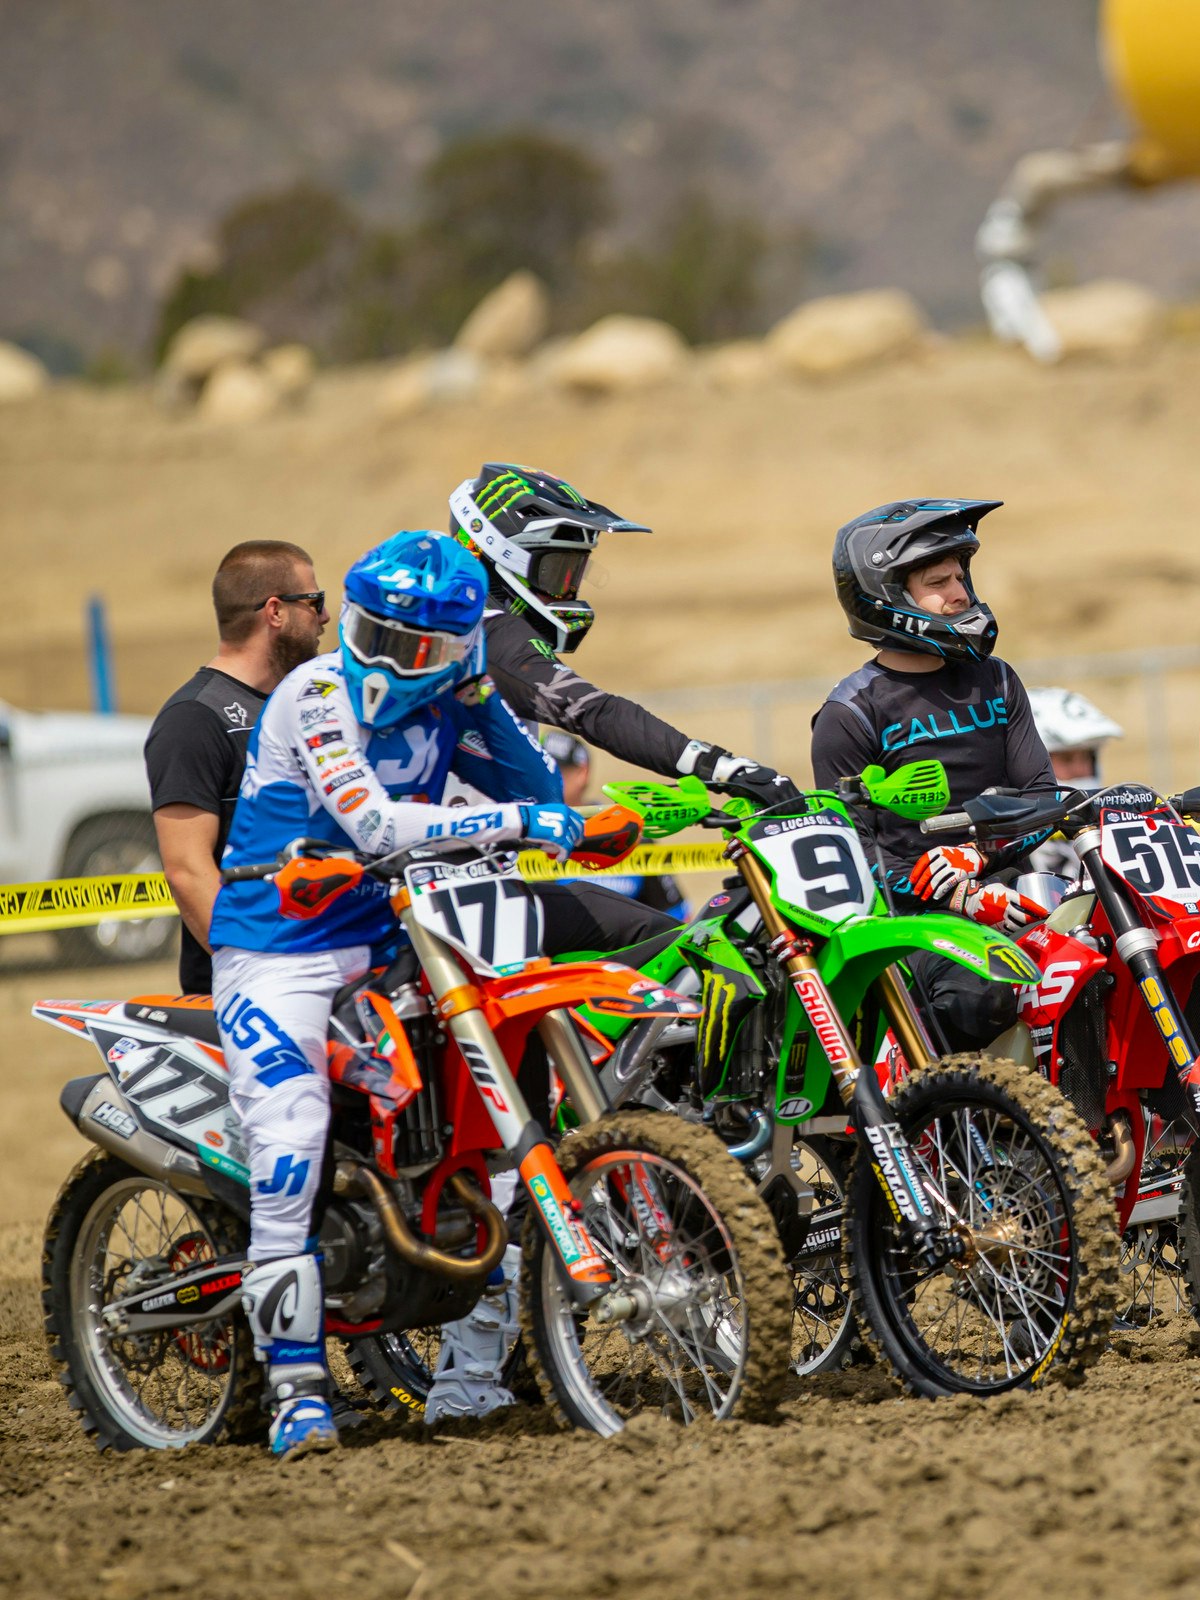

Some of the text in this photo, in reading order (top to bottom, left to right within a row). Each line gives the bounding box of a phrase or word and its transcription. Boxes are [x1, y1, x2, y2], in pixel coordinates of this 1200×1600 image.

[892, 612, 930, 637] FLY
[880, 697, 1008, 750] CALLUS
[643, 807, 700, 821] ACERBIS
[781, 815, 832, 832] LUCAS OIL
[889, 791, 947, 804] ACERBIS
[468, 863, 492, 877] OIL
[791, 833, 864, 911] 9
[428, 878, 540, 966] 177
[788, 904, 827, 926] Kawasaki
[216, 991, 314, 1089] UST1
[793, 979, 851, 1064] SHOWA
[1140, 976, 1192, 1068] SSS
[94, 1102, 138, 1132] HGS
[864, 1125, 918, 1223] DUNLOP
[870, 1162, 903, 1224] ACERBIS
[540, 1197, 578, 1261] MOTOREX
